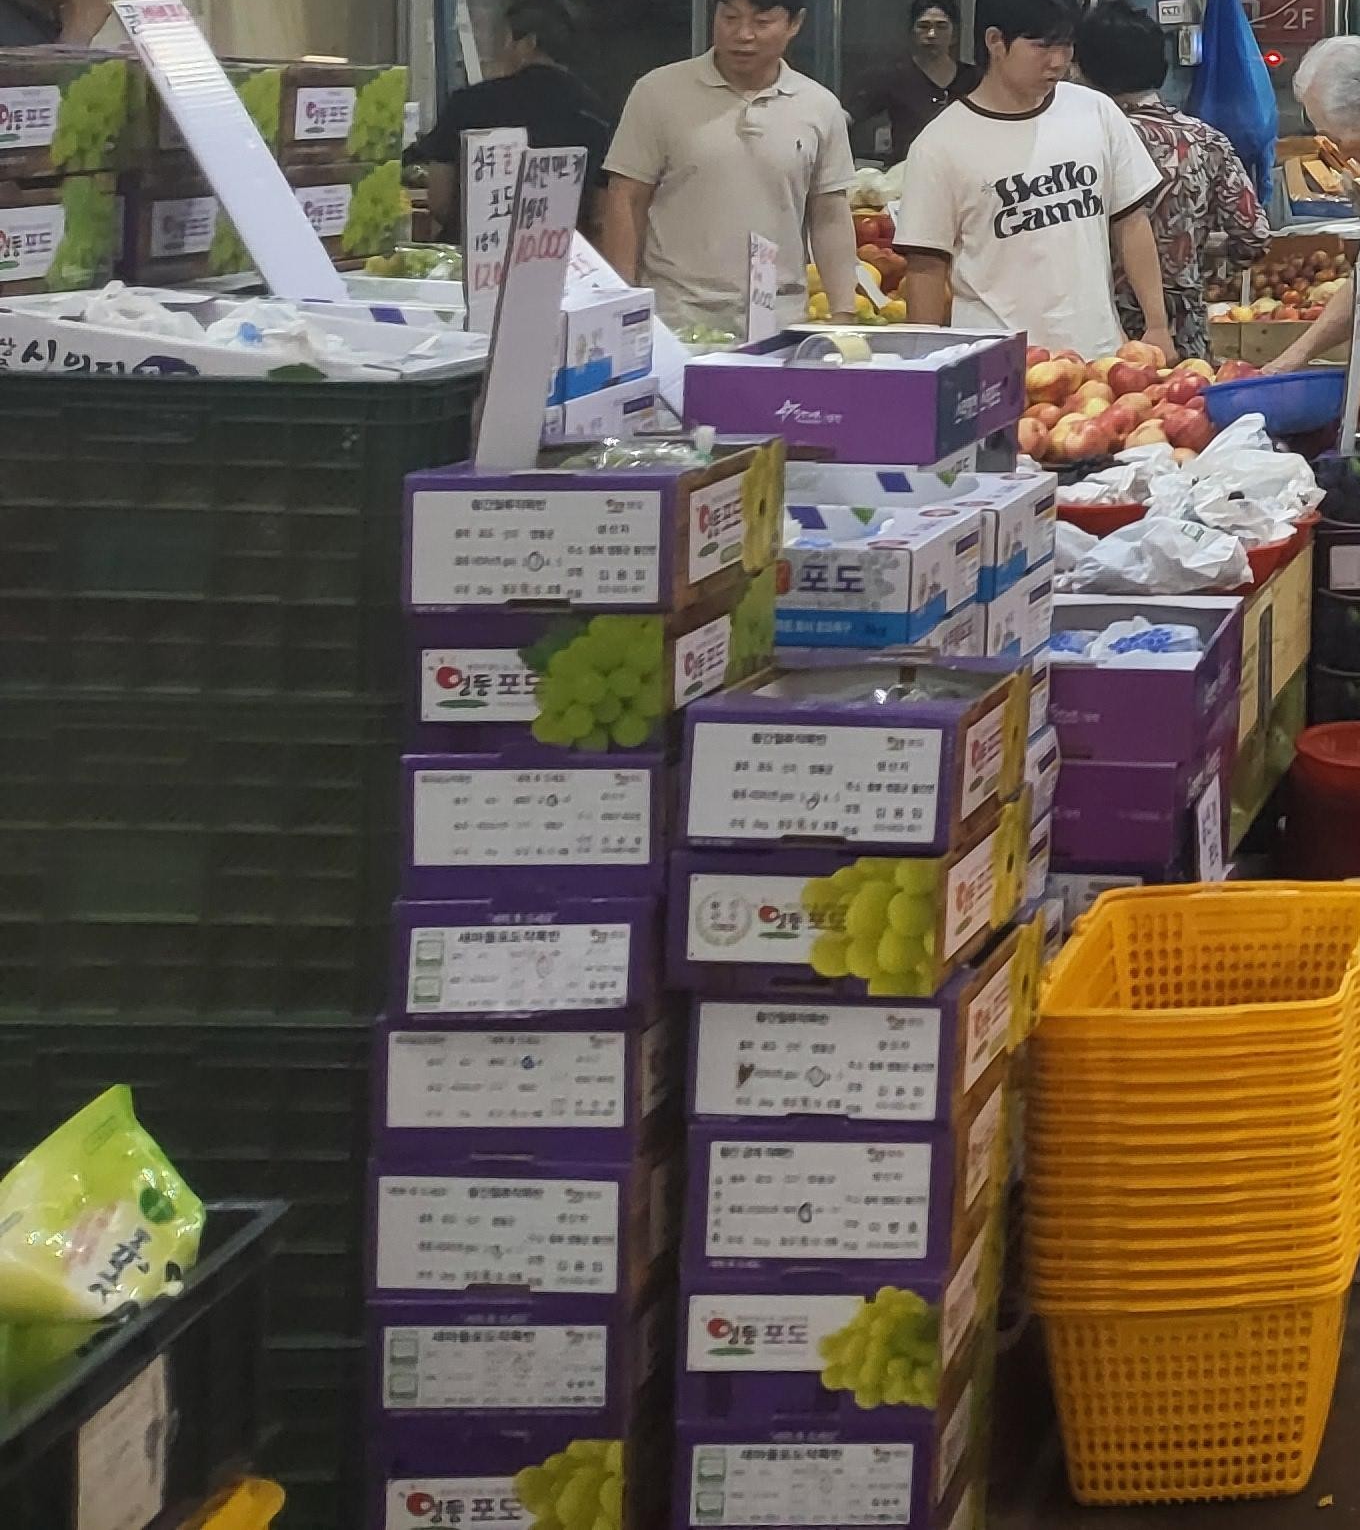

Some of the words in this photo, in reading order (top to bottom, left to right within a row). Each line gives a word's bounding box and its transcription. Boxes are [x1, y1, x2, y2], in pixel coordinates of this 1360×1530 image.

[1282, 8, 1316, 31] 2F
[994, 160, 1098, 209] Hello
[797, 564, 866, 593] 포도
[763, 1324, 809, 1344] 포도
